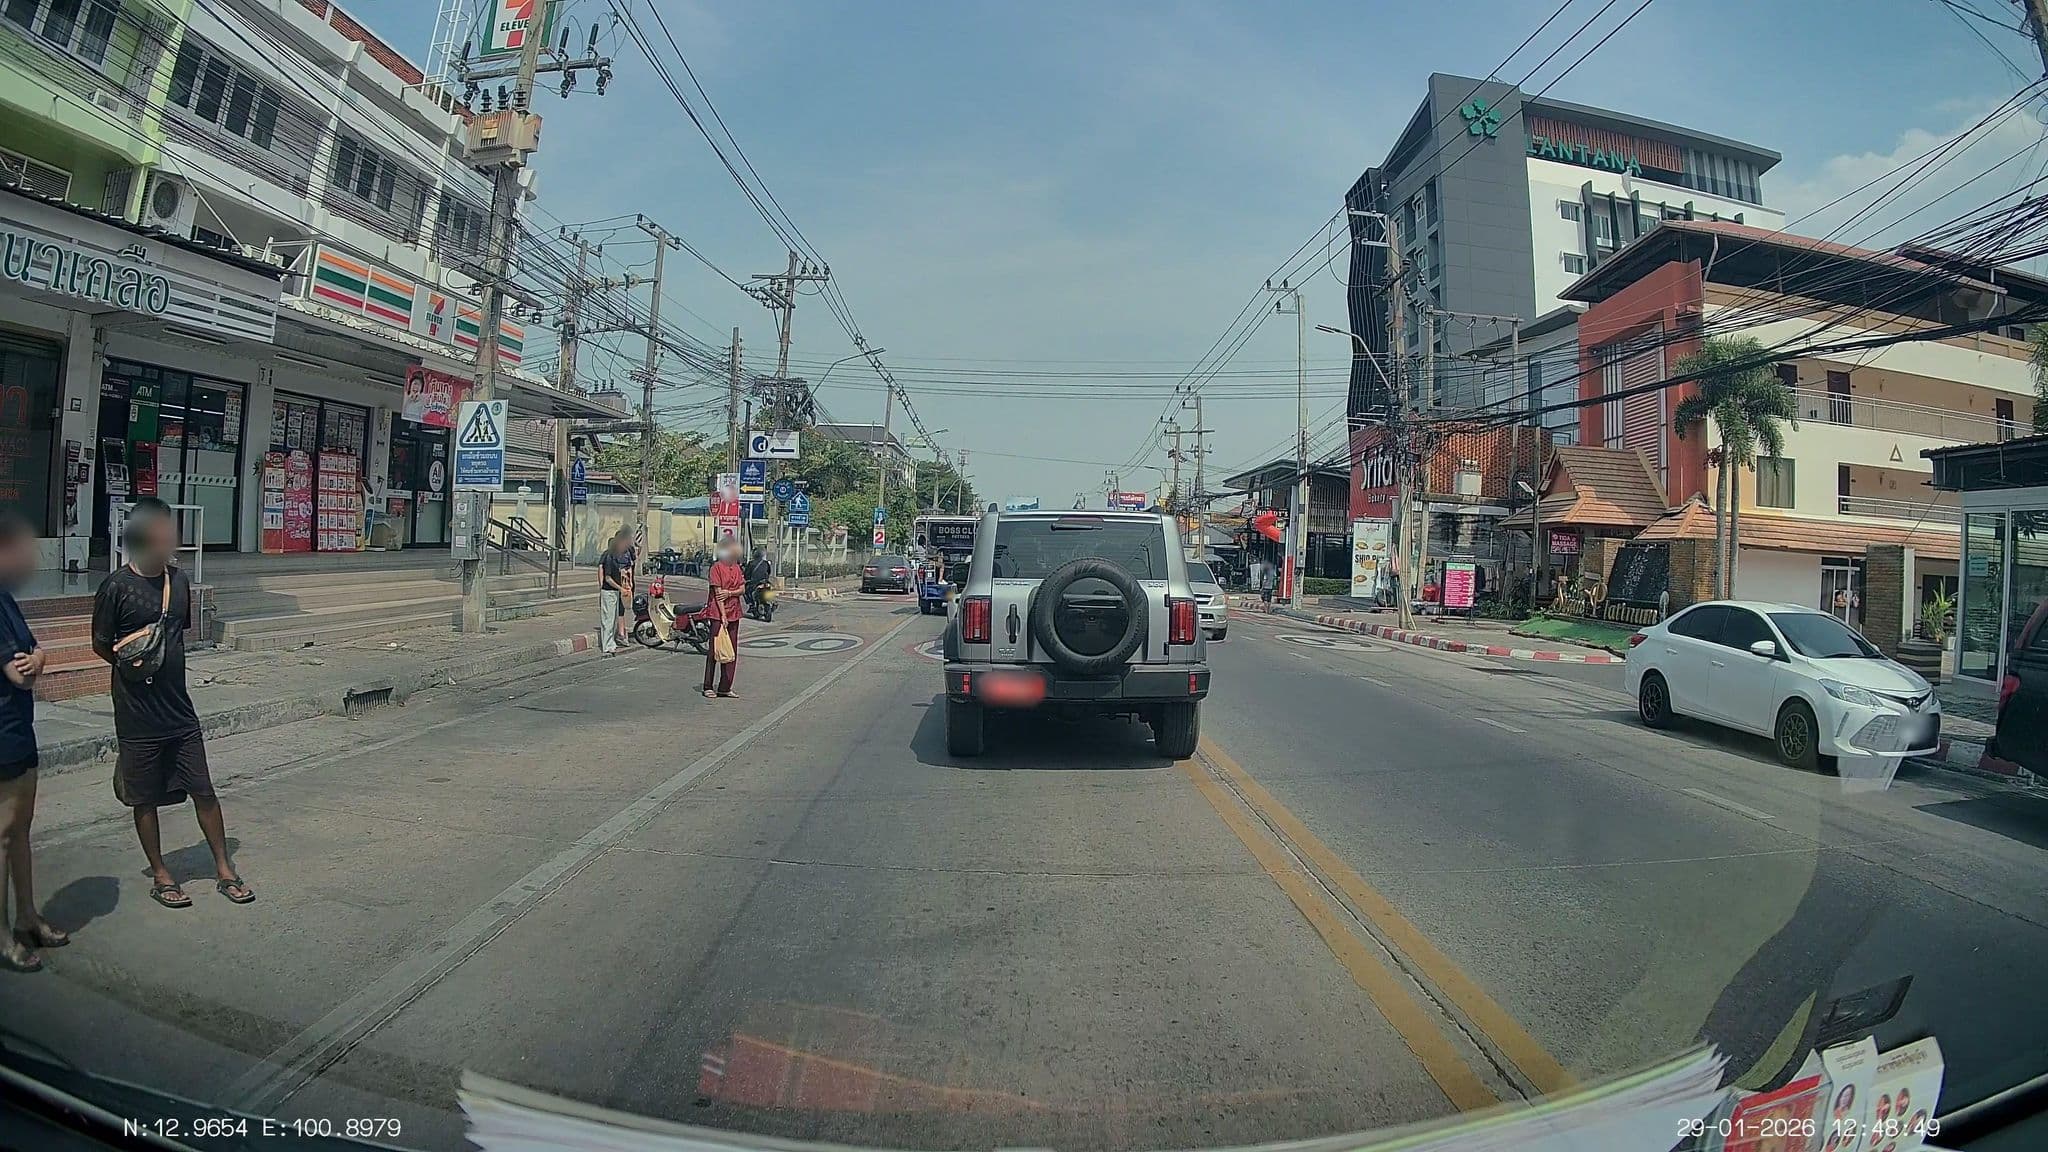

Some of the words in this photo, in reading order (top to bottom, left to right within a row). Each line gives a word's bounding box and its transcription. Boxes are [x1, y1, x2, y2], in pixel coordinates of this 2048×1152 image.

[1526, 133, 1643, 176] LANTANA
[3, 232, 171, 315] นาเกลือ
[136, 385, 153, 398] ATM
[938, 526, 961, 534] BOSS
[962, 527, 975, 535] CL
[875, 532, 884, 544] 2
